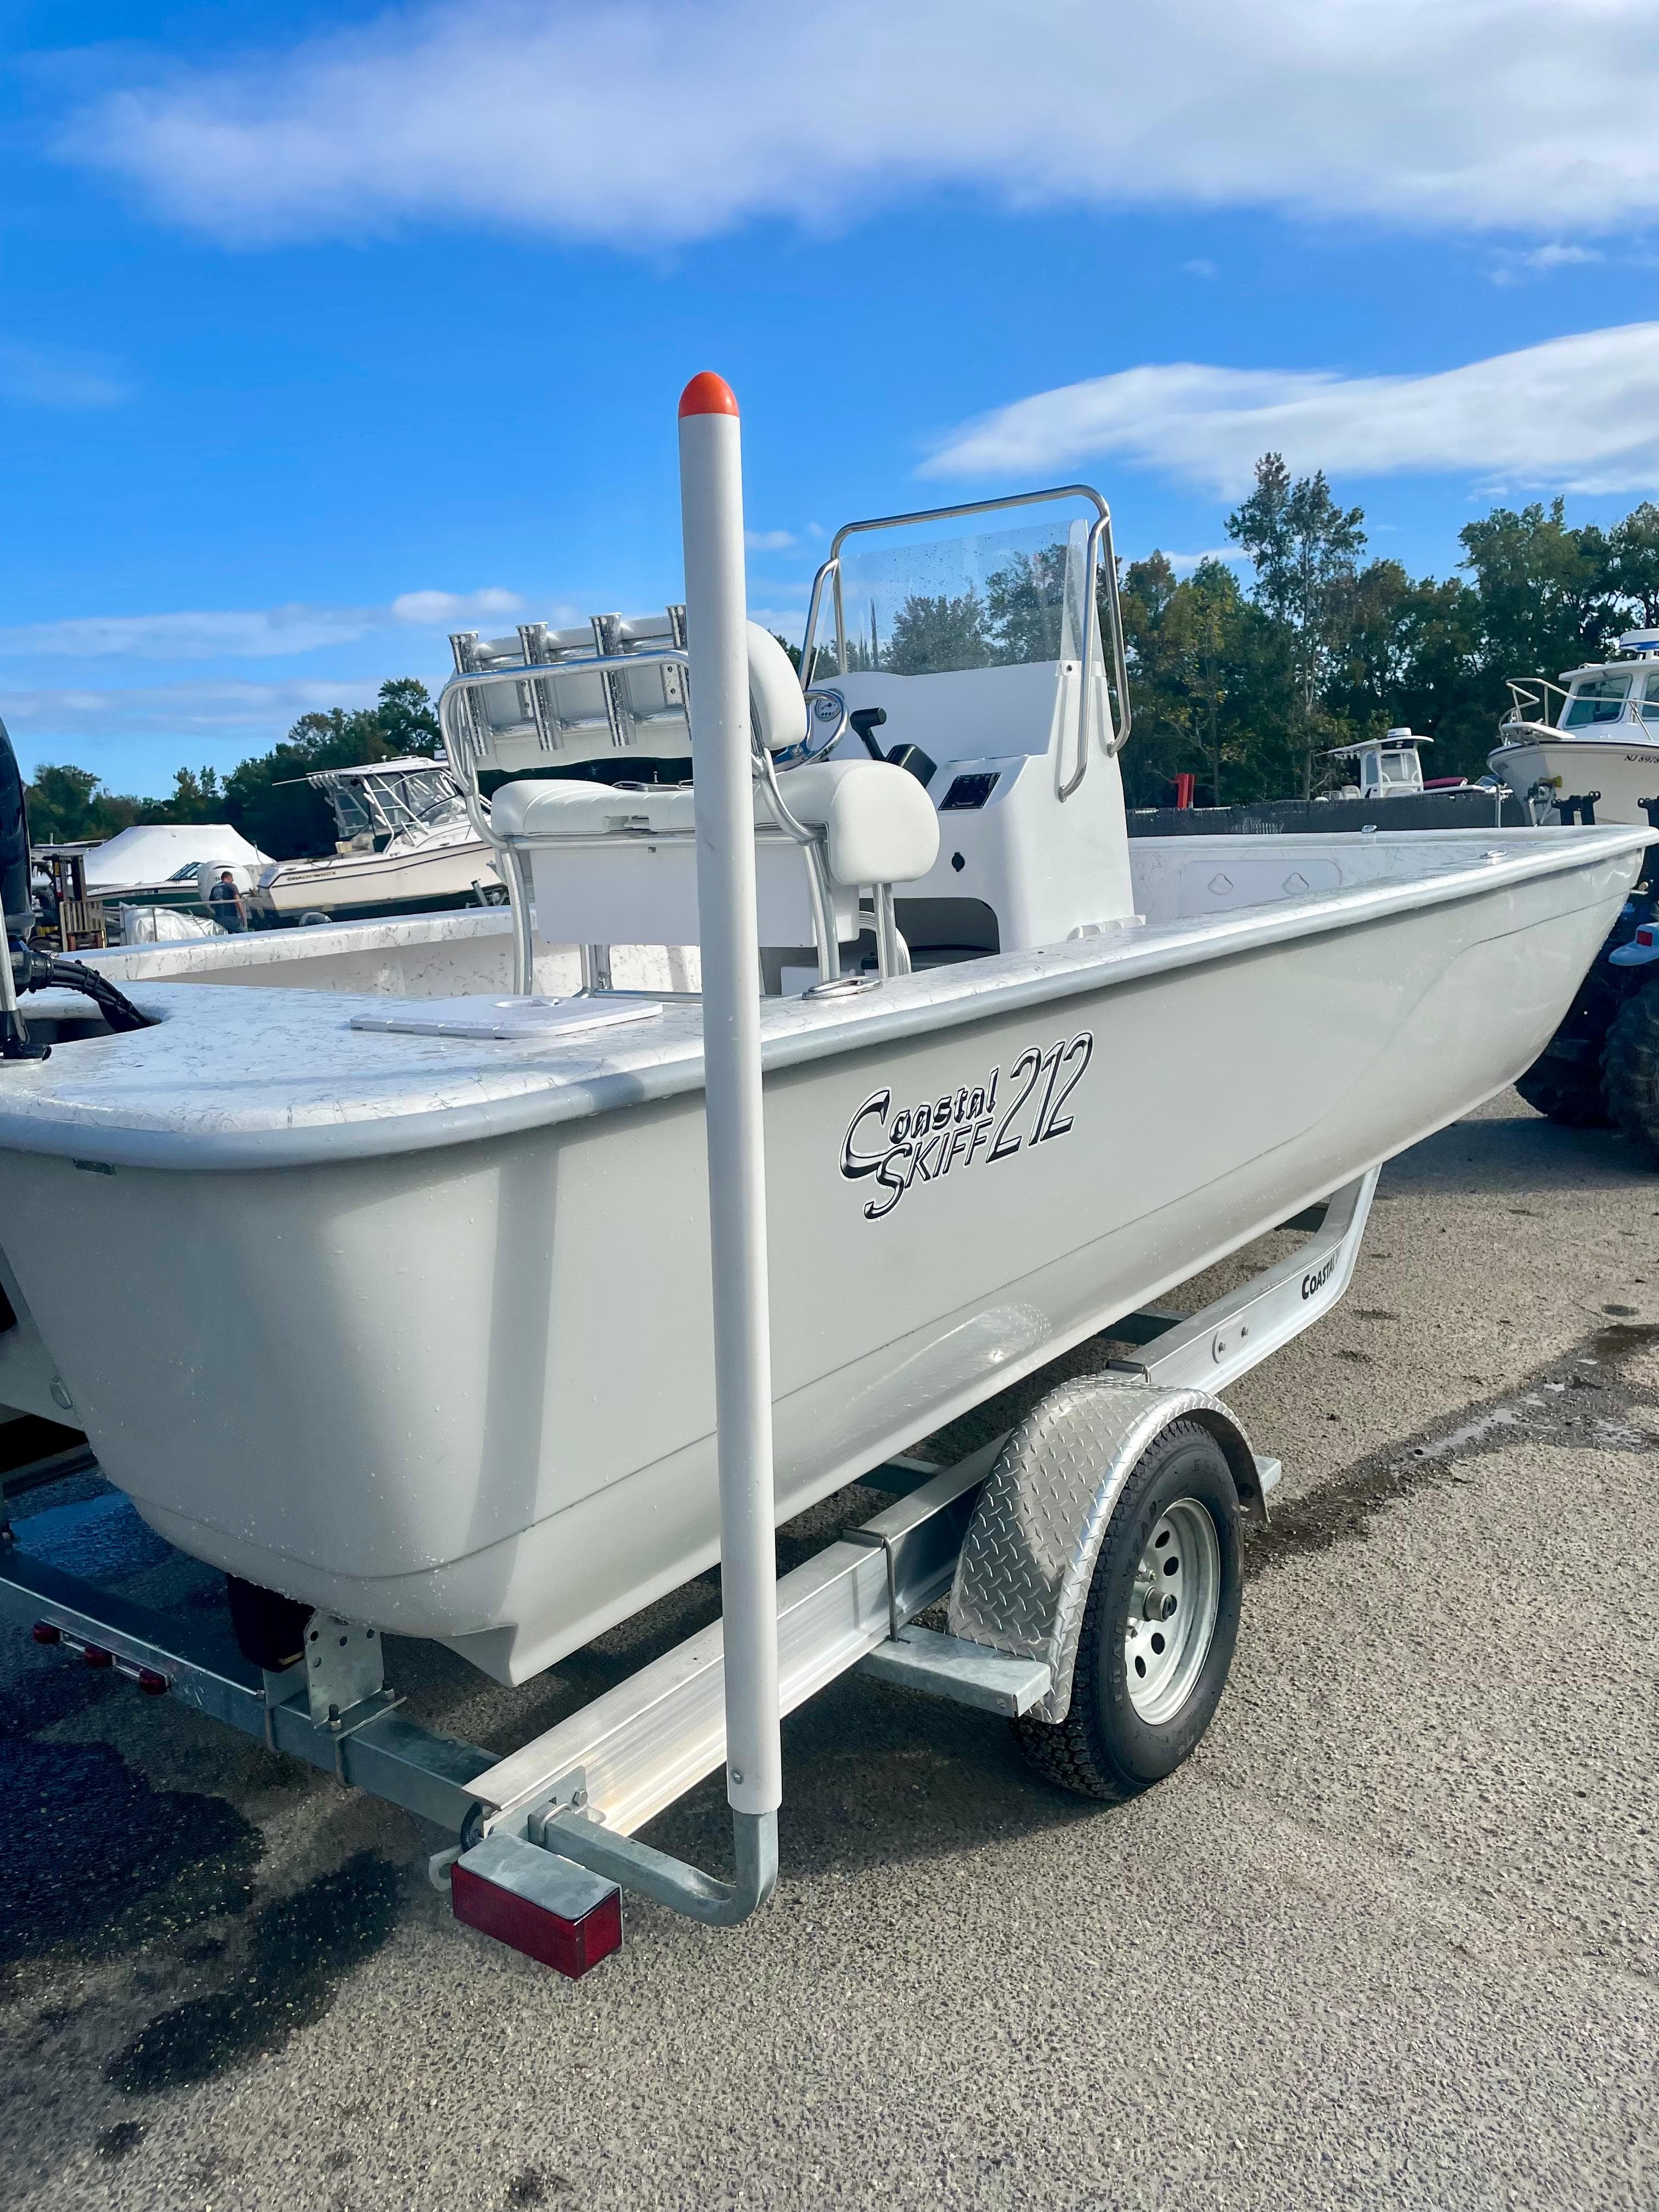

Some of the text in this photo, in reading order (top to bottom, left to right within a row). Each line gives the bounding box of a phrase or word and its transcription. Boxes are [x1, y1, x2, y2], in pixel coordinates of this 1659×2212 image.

[840, 1031, 1093, 1179] Coastal 212
[864, 1116, 993, 1220] SKIFF
